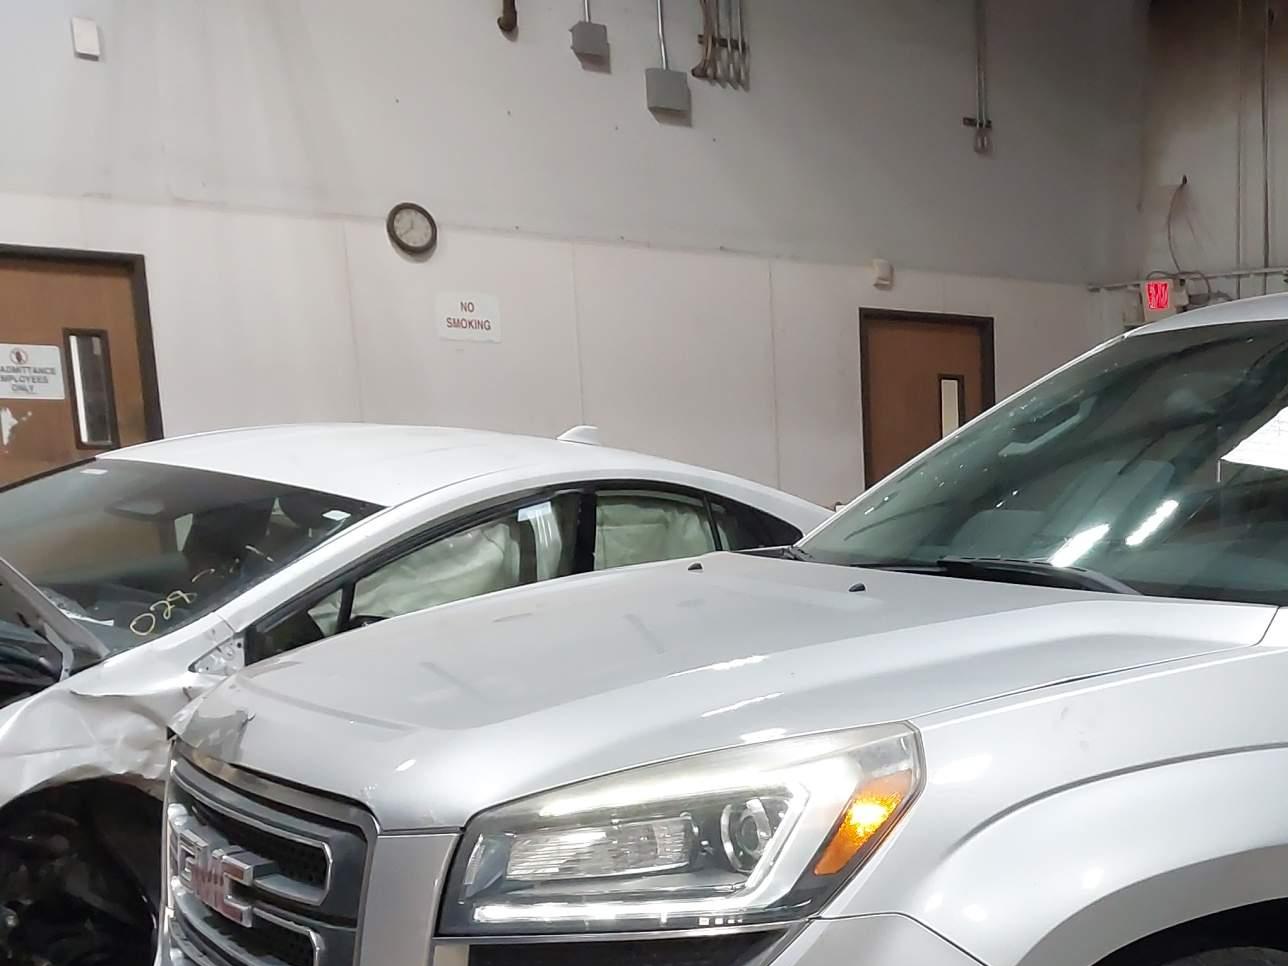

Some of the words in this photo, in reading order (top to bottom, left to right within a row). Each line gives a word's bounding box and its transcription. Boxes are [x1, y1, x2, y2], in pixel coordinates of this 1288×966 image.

[460, 301, 475, 313] NO
[446, 317, 492, 331] SMOKING
[176, 829, 253, 928] GMC
